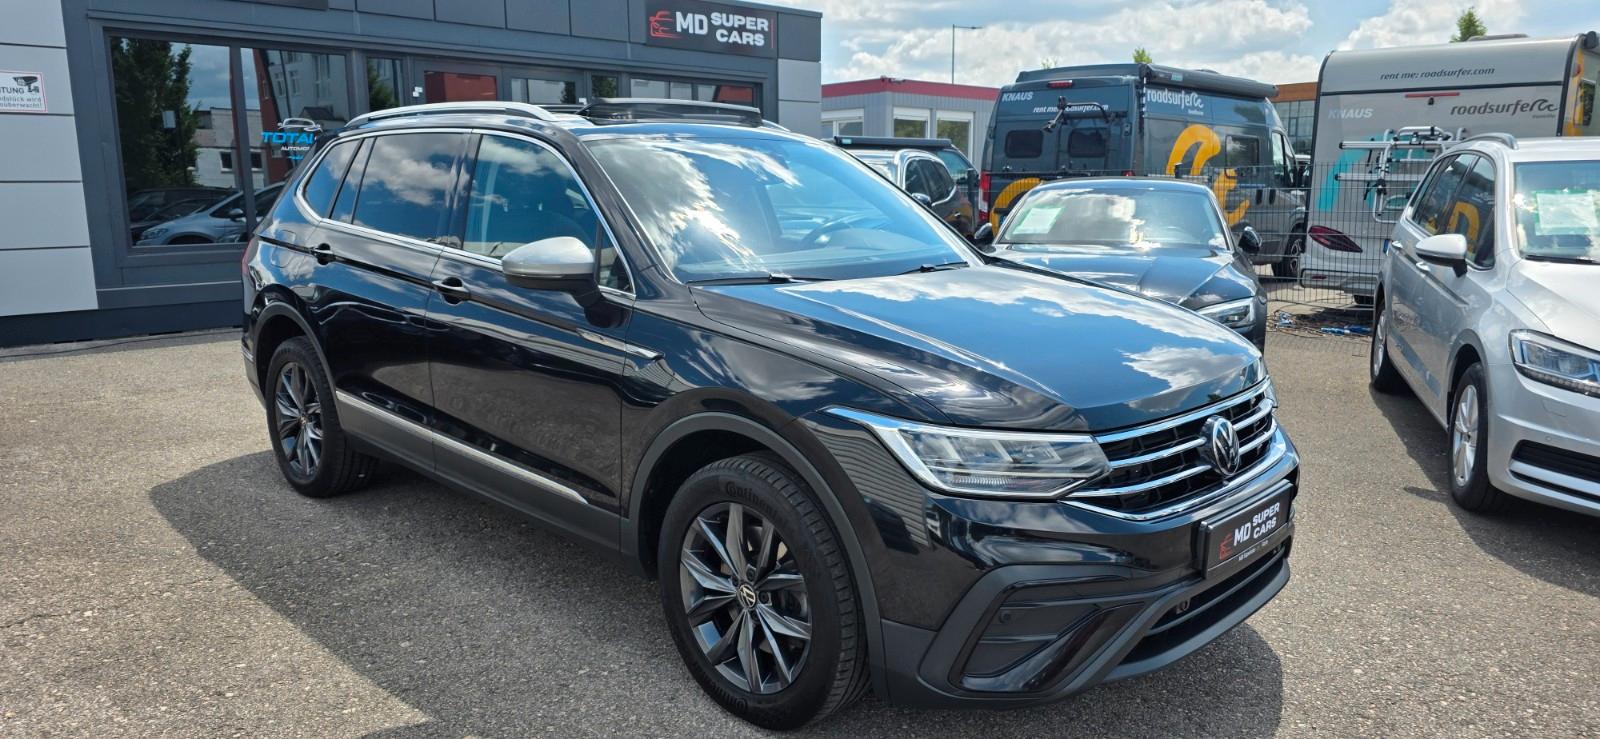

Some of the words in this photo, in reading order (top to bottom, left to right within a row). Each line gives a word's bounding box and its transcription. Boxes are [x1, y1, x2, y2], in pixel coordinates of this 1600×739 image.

[675, 11, 708, 35] MD
[710, 12, 769, 32] SUPER
[715, 29, 765, 47] CARS
[1380, 72, 1399, 81] rent
[1420, 67, 1495, 79] roadsurfer.com
[0, 86, 25, 94] TUNG
[1001, 91, 1034, 102] KNAUS
[1328, 108, 1374, 119] KNAUS
[1233, 522, 1252, 546] MD
[1252, 502, 1280, 526] SUPER
[1253, 517, 1277, 539] CARS
